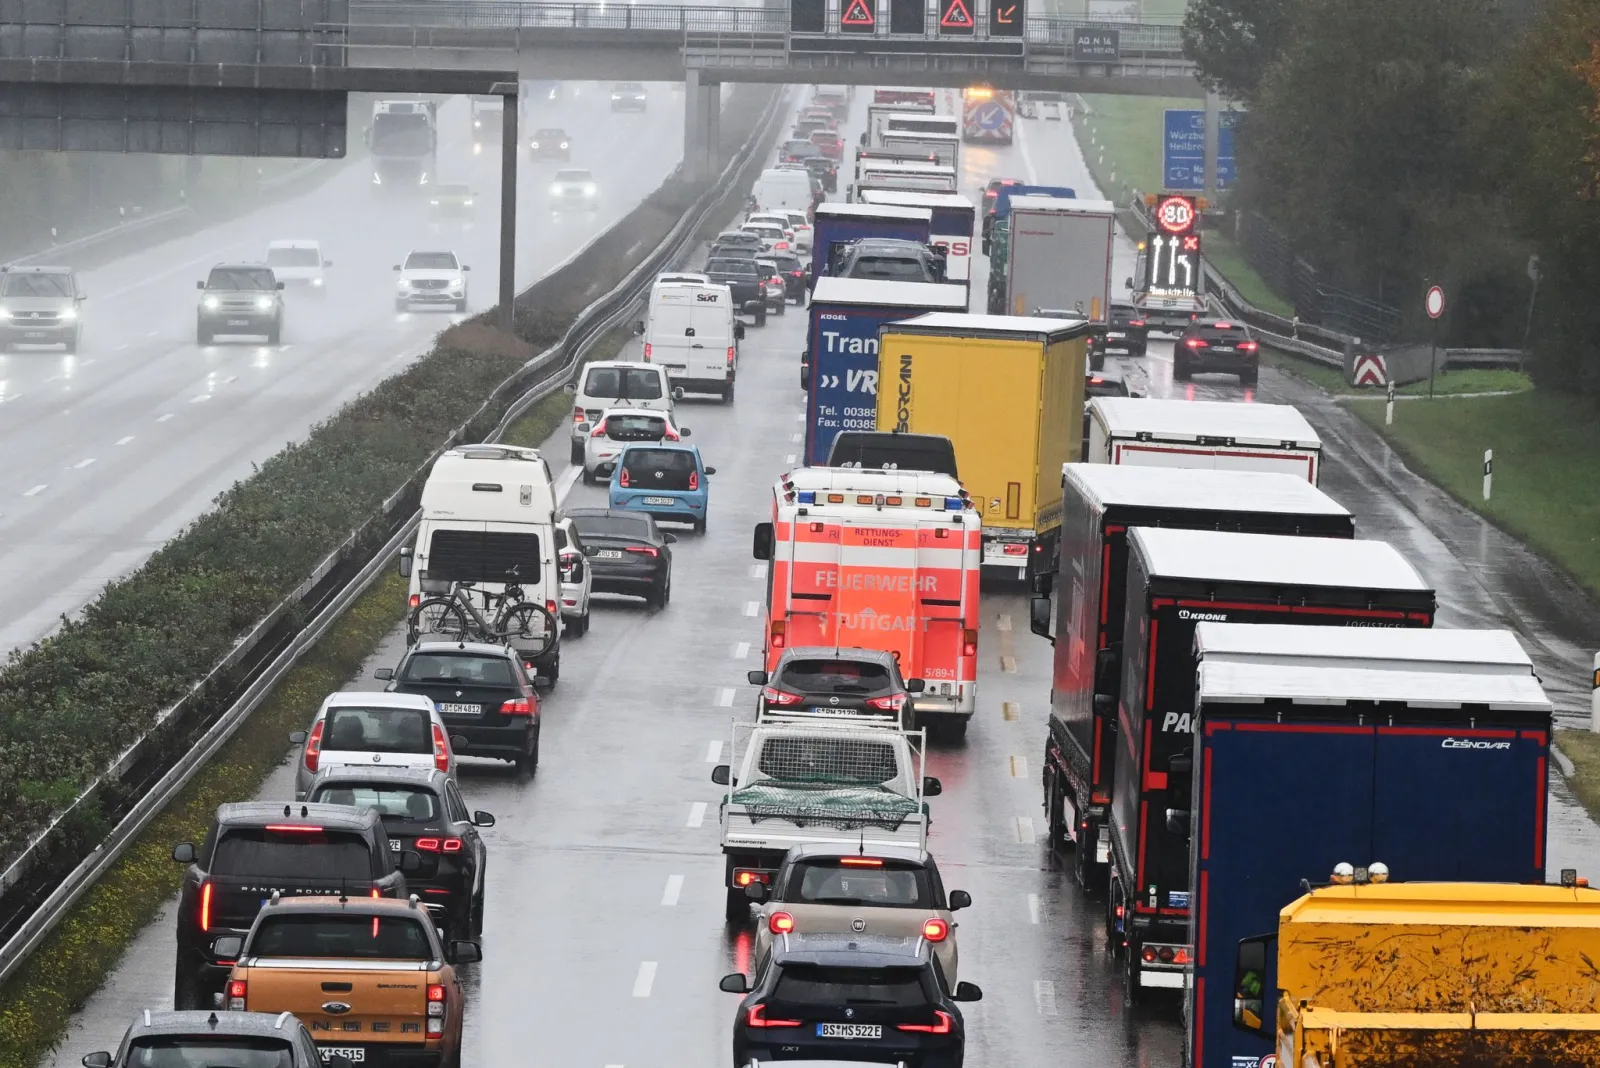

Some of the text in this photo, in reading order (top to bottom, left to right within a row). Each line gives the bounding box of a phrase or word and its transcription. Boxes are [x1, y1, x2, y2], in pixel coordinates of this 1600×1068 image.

[1164, 205, 1187, 223] 80
[822, 331, 878, 354] Tran
[819, 405, 838, 416] Tel.
[817, 417, 840, 428] Fax:
[854, 528, 903, 538] RETTUNGS-
[863, 537, 895, 547] DIENST
[815, 570, 937, 592] FEUERWEHR
[1190, 612, 1227, 621] KRONE
[925, 668, 955, 678] 5/89-1
[453, 704, 463, 712] CH
[464, 705, 480, 713] 4812
[1441, 736, 1511, 750] ČEŠNOVAR
[823, 1024, 836, 1036] BS
[841, 1025, 854, 1036] MS
[342, 1049, 364, 1061] 515
